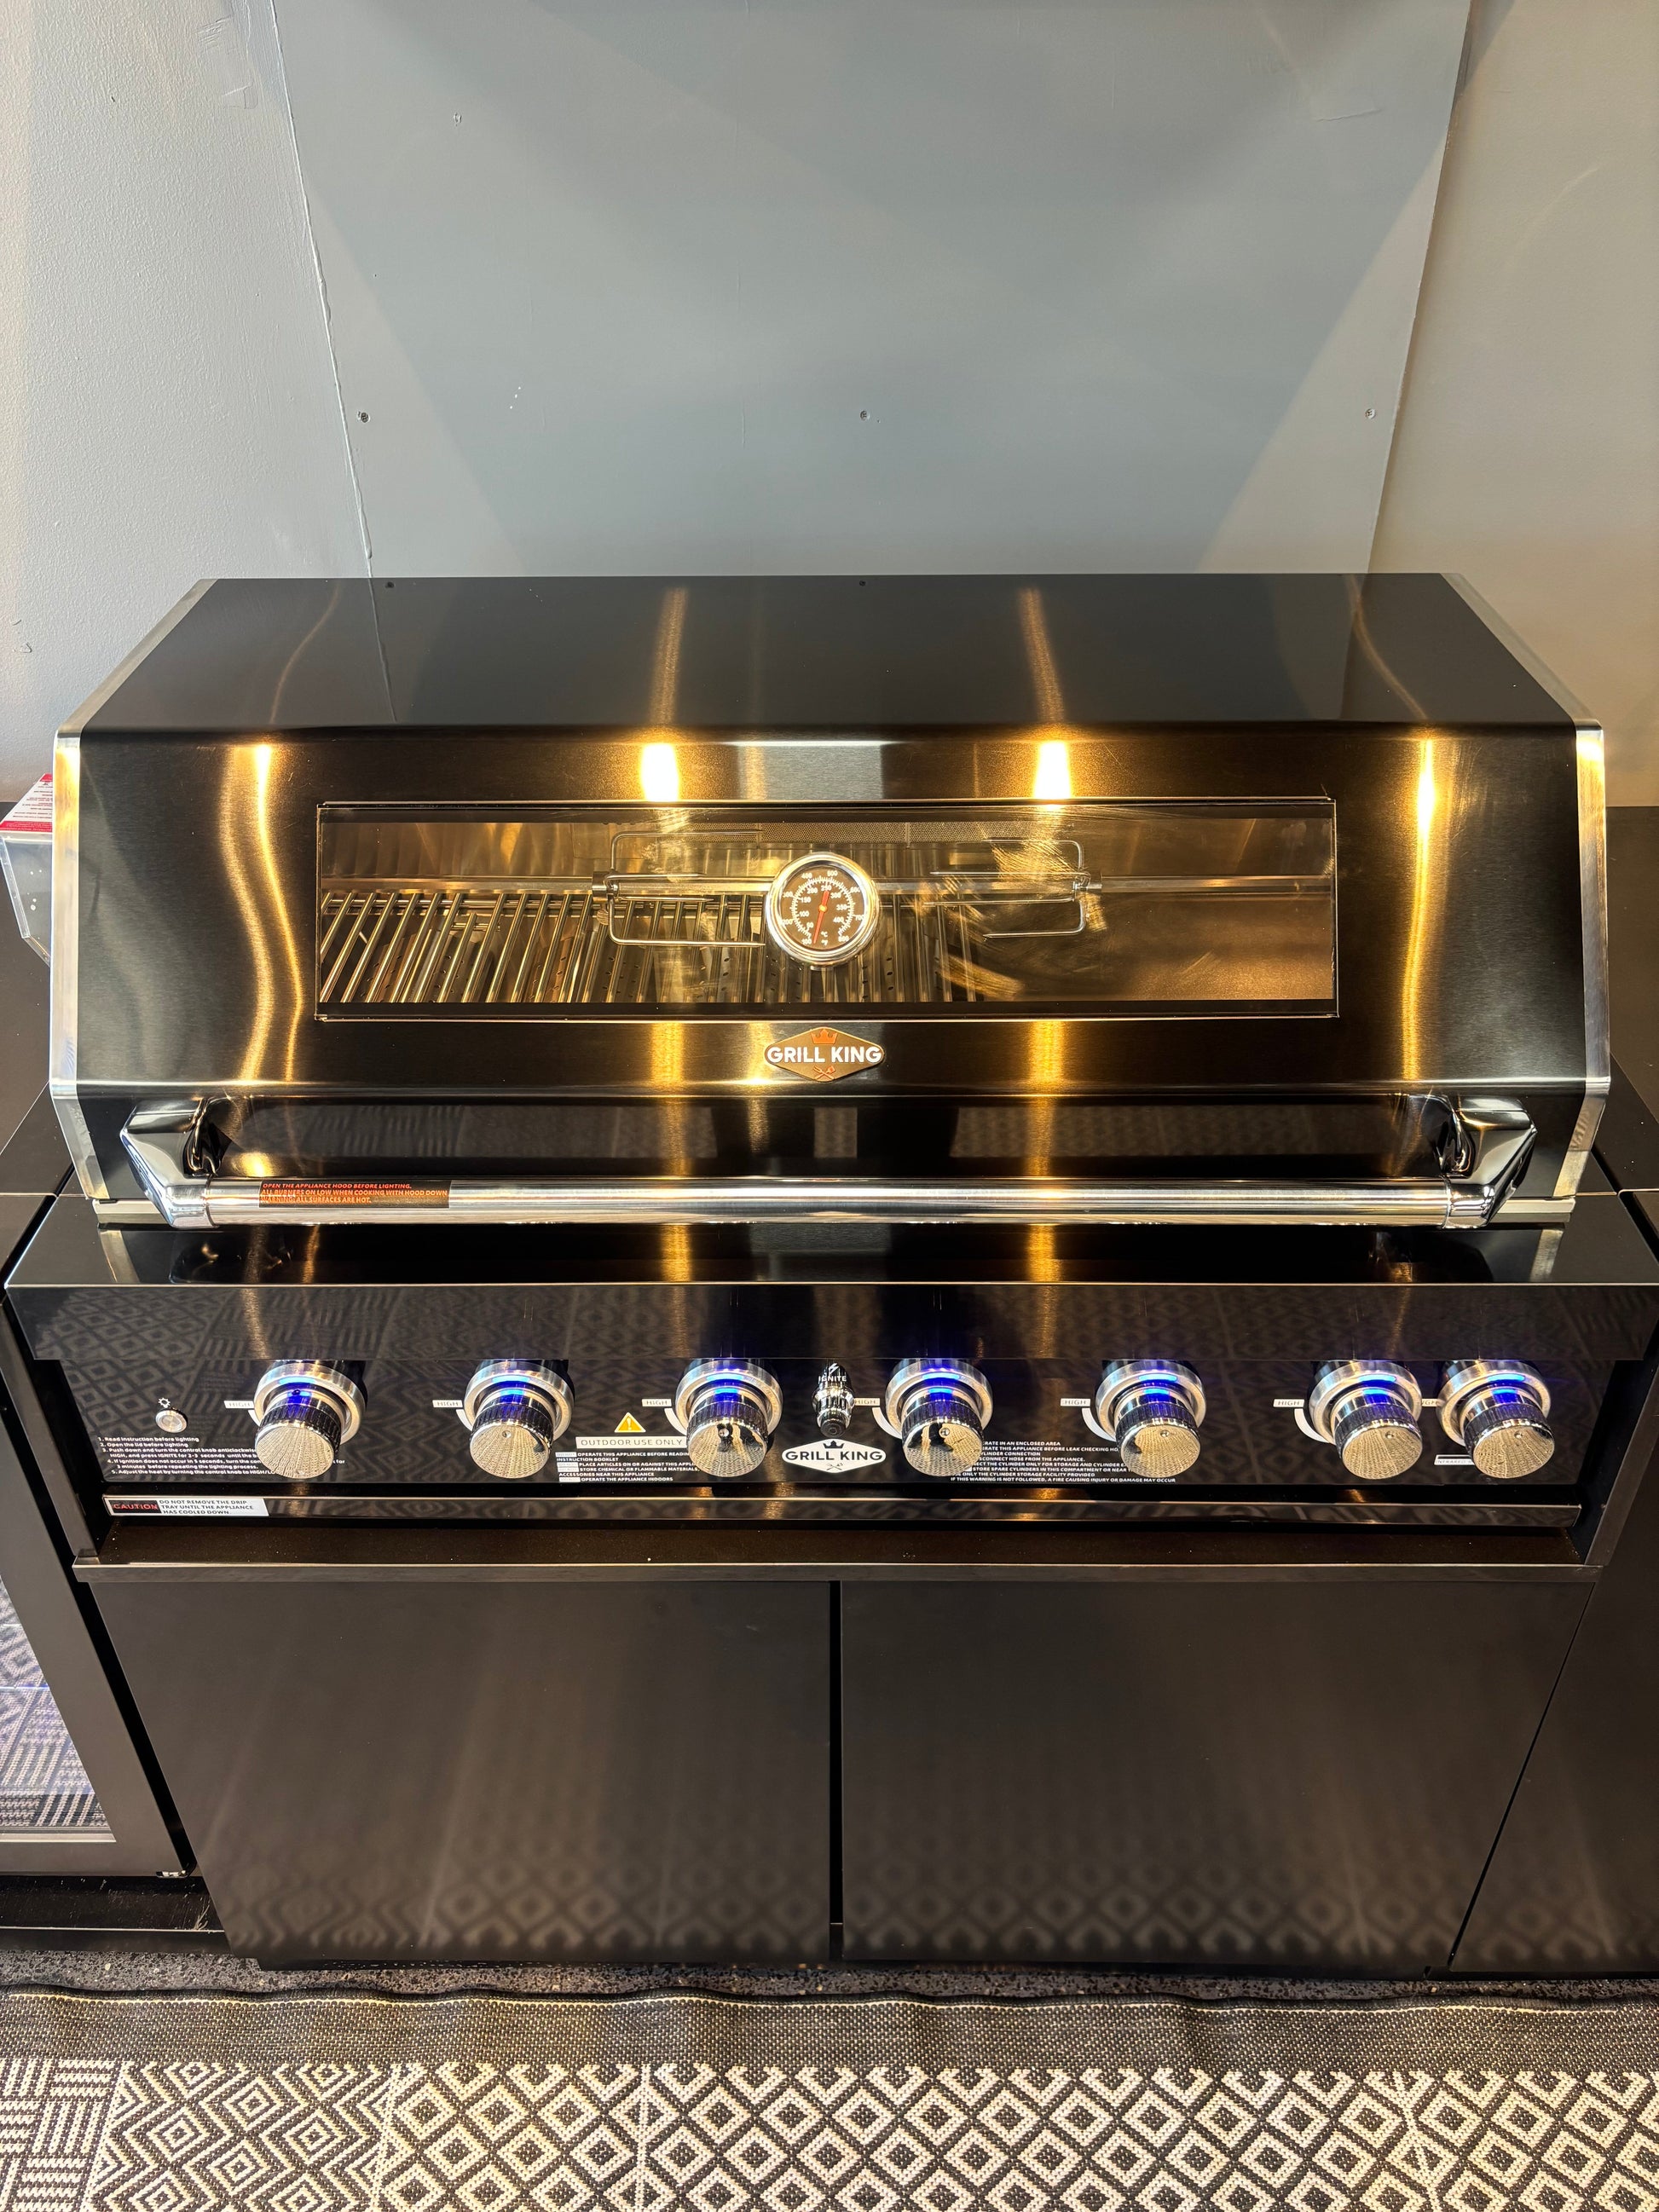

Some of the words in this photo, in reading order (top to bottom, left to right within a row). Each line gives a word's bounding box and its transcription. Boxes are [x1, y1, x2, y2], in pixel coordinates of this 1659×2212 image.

[766, 1046, 826, 1063] GRILL
[830, 1046, 882, 1063] KING
[785, 1451, 837, 1461] GRILL
[840, 1451, 883, 1461] KING
